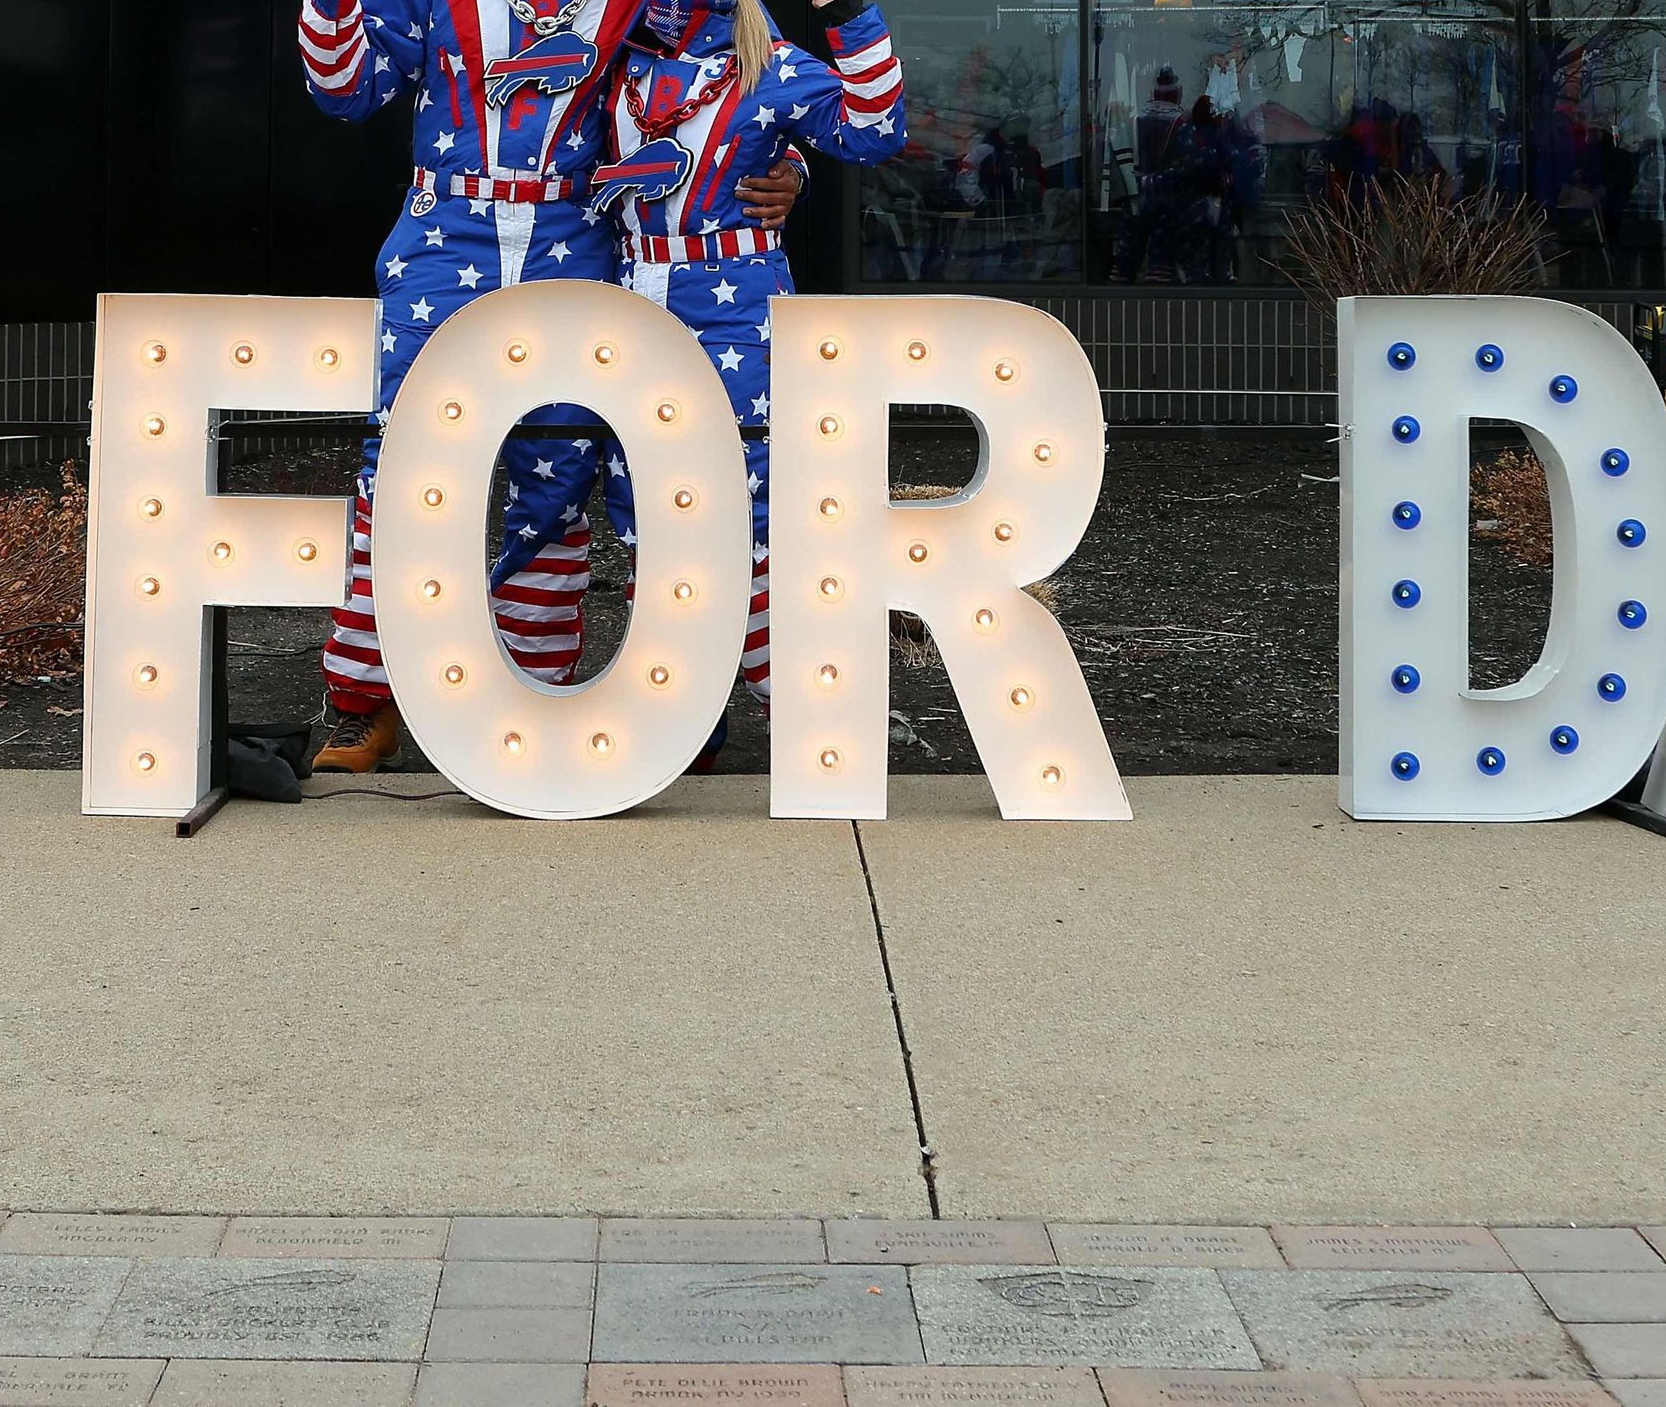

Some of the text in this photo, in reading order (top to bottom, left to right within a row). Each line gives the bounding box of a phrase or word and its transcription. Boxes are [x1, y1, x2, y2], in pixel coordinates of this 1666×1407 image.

[81, 278, 1132, 822] FOR
[621, 1378, 667, 1387] PETE
[737, 1378, 809, 1387] BROWN
